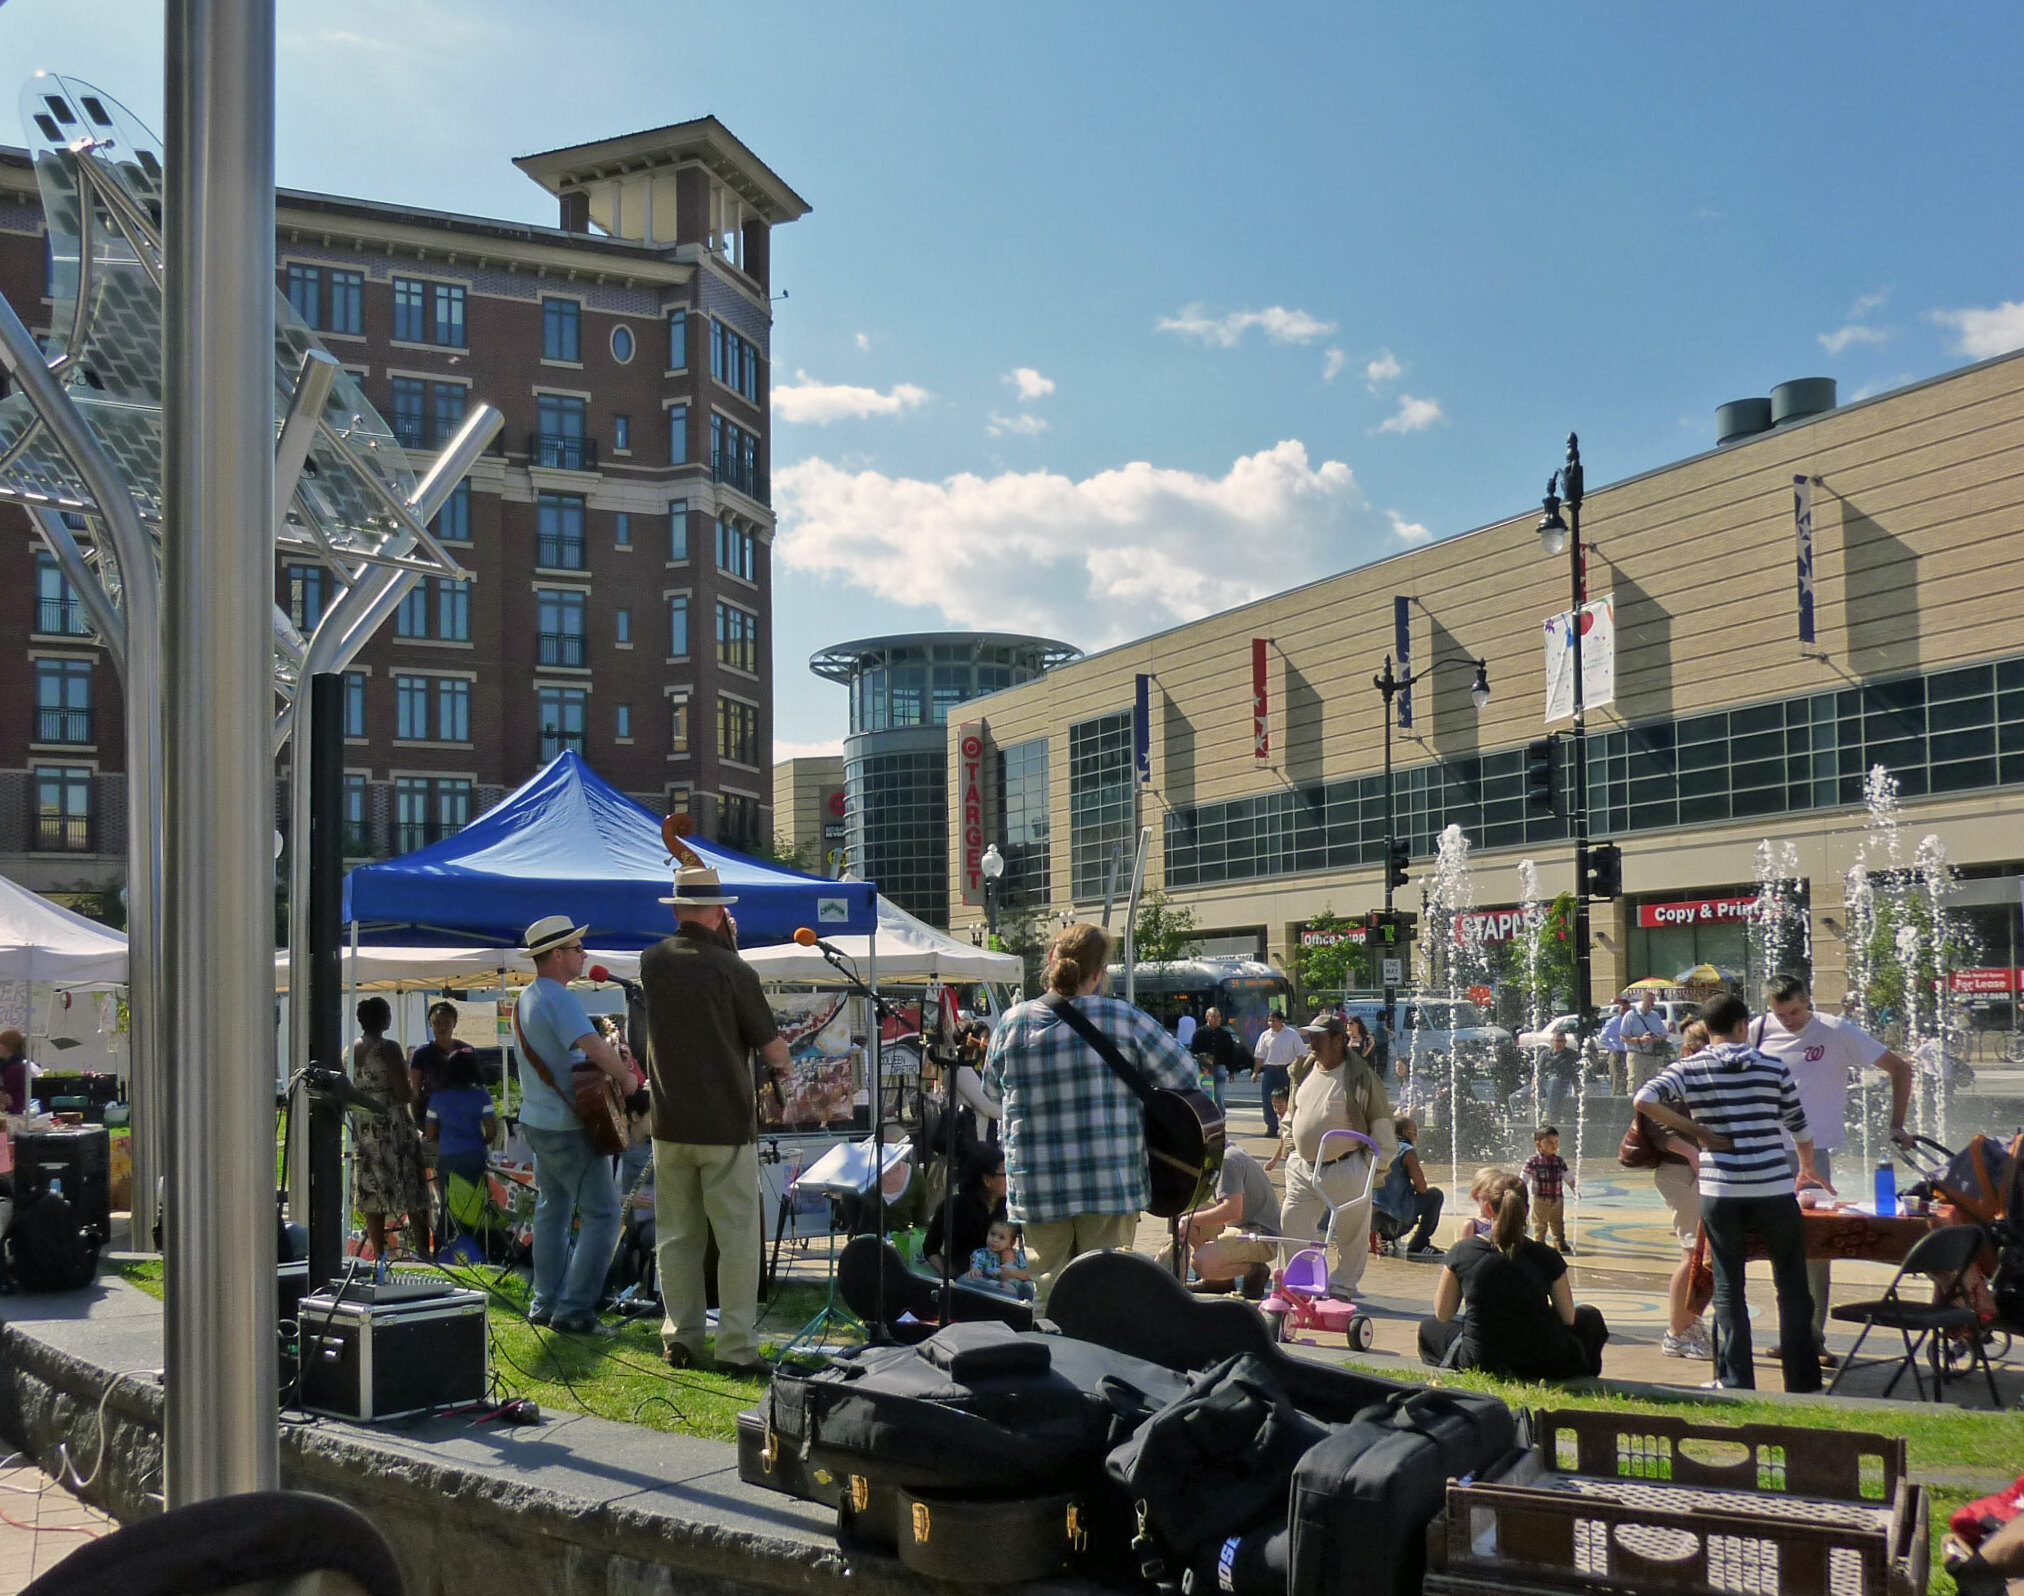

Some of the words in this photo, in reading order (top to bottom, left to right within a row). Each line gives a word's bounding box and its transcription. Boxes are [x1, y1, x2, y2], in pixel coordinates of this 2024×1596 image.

[964, 762, 982, 890] TARGET
[1461, 909, 1543, 941] STAPL
[1654, 906, 1695, 923] Copy
[1700, 903, 1713, 918] &
[1304, 933, 1336, 946] Office
[1955, 979, 1974, 988] For
[1976, 979, 2006, 988] Lease
[1218, 1536, 1242, 1592] BOSE
